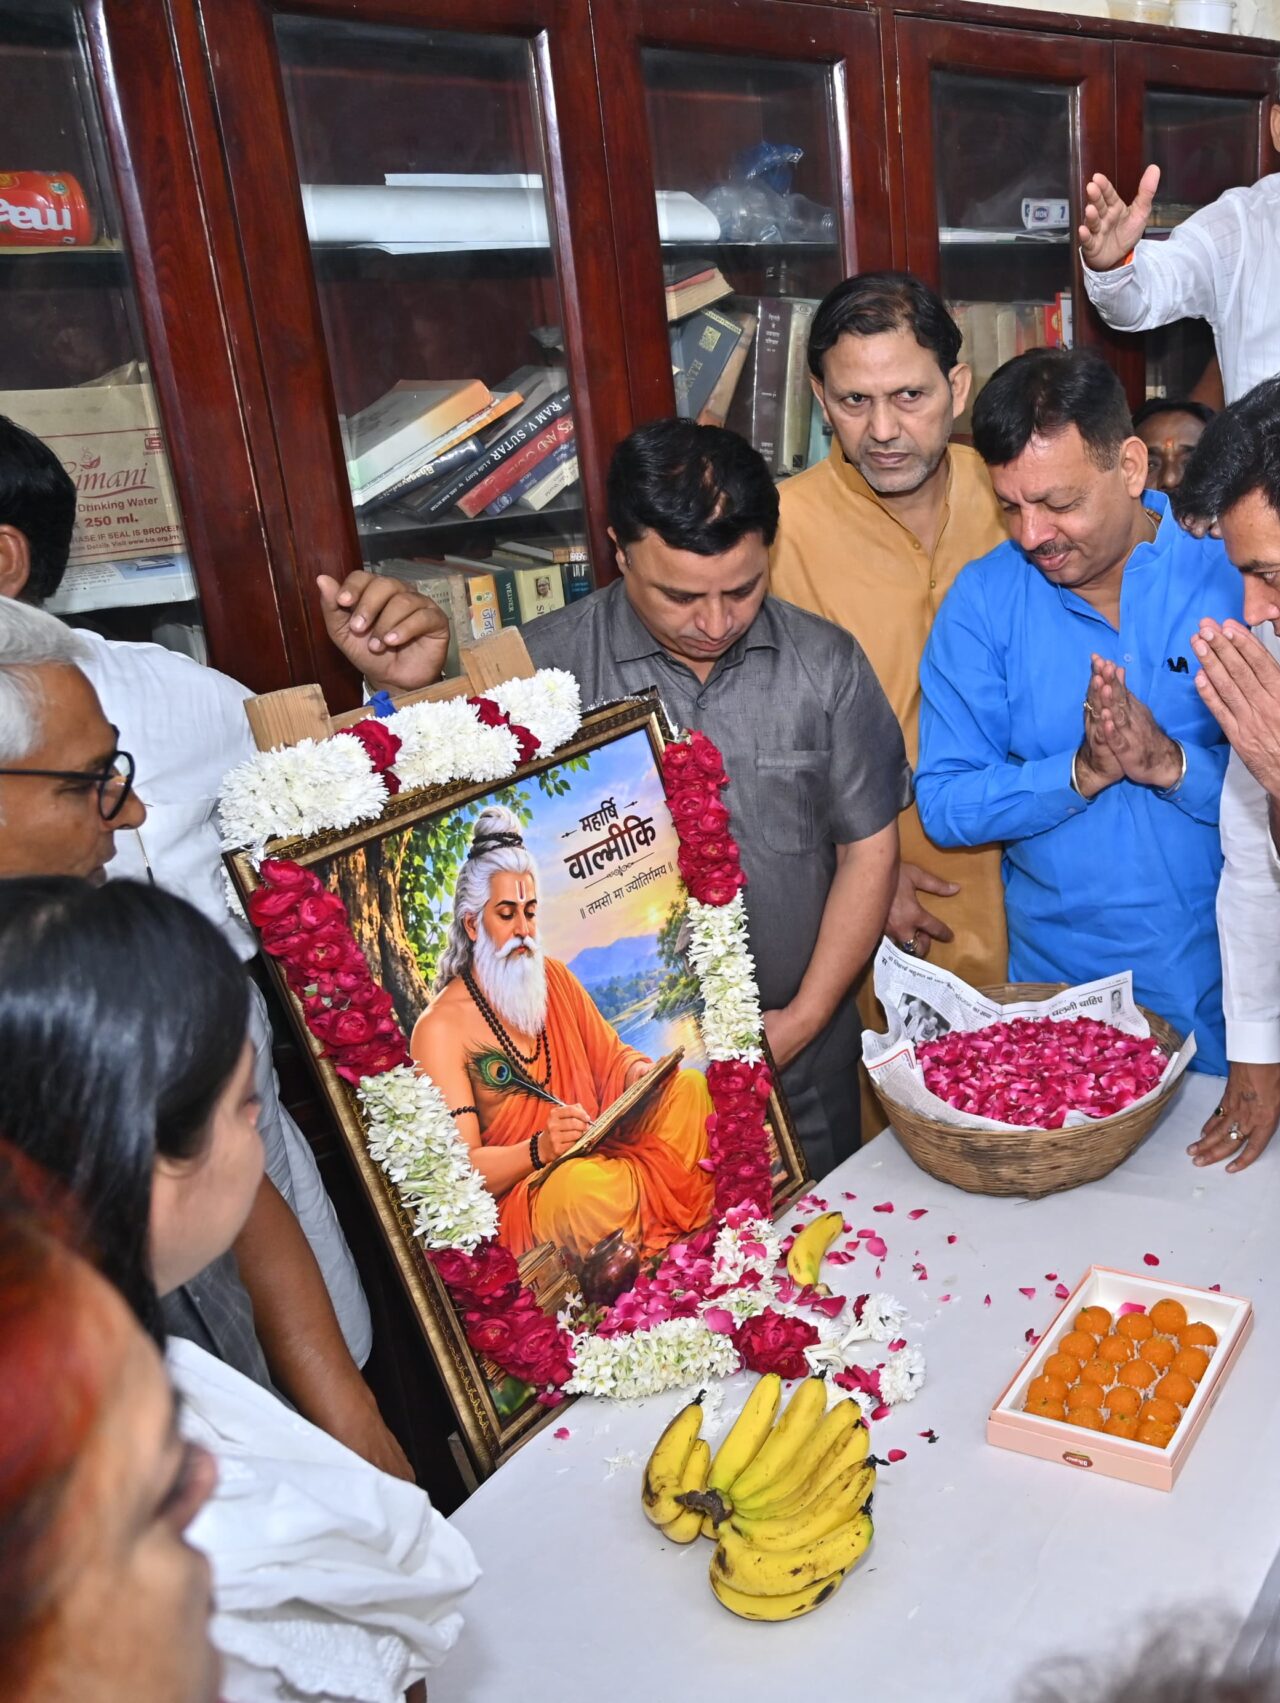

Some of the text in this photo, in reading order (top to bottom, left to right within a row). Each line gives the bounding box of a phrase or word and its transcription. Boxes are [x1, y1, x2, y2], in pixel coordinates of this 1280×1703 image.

[535, 401, 562, 425] RAM
[490, 429, 527, 461] SUTAR
[78, 497, 158, 513] Drinking Water
[84, 513, 139, 528] 250 ml.
[108, 529, 131, 540] SEAL
[132, 528, 141, 538] IS
[563, 815, 656, 879] वाल्मीकि
[586, 891, 613, 915] तमसो
[613, 887, 625, 900] मा
[624, 865, 667, 893] ज्योतिर्गमय
